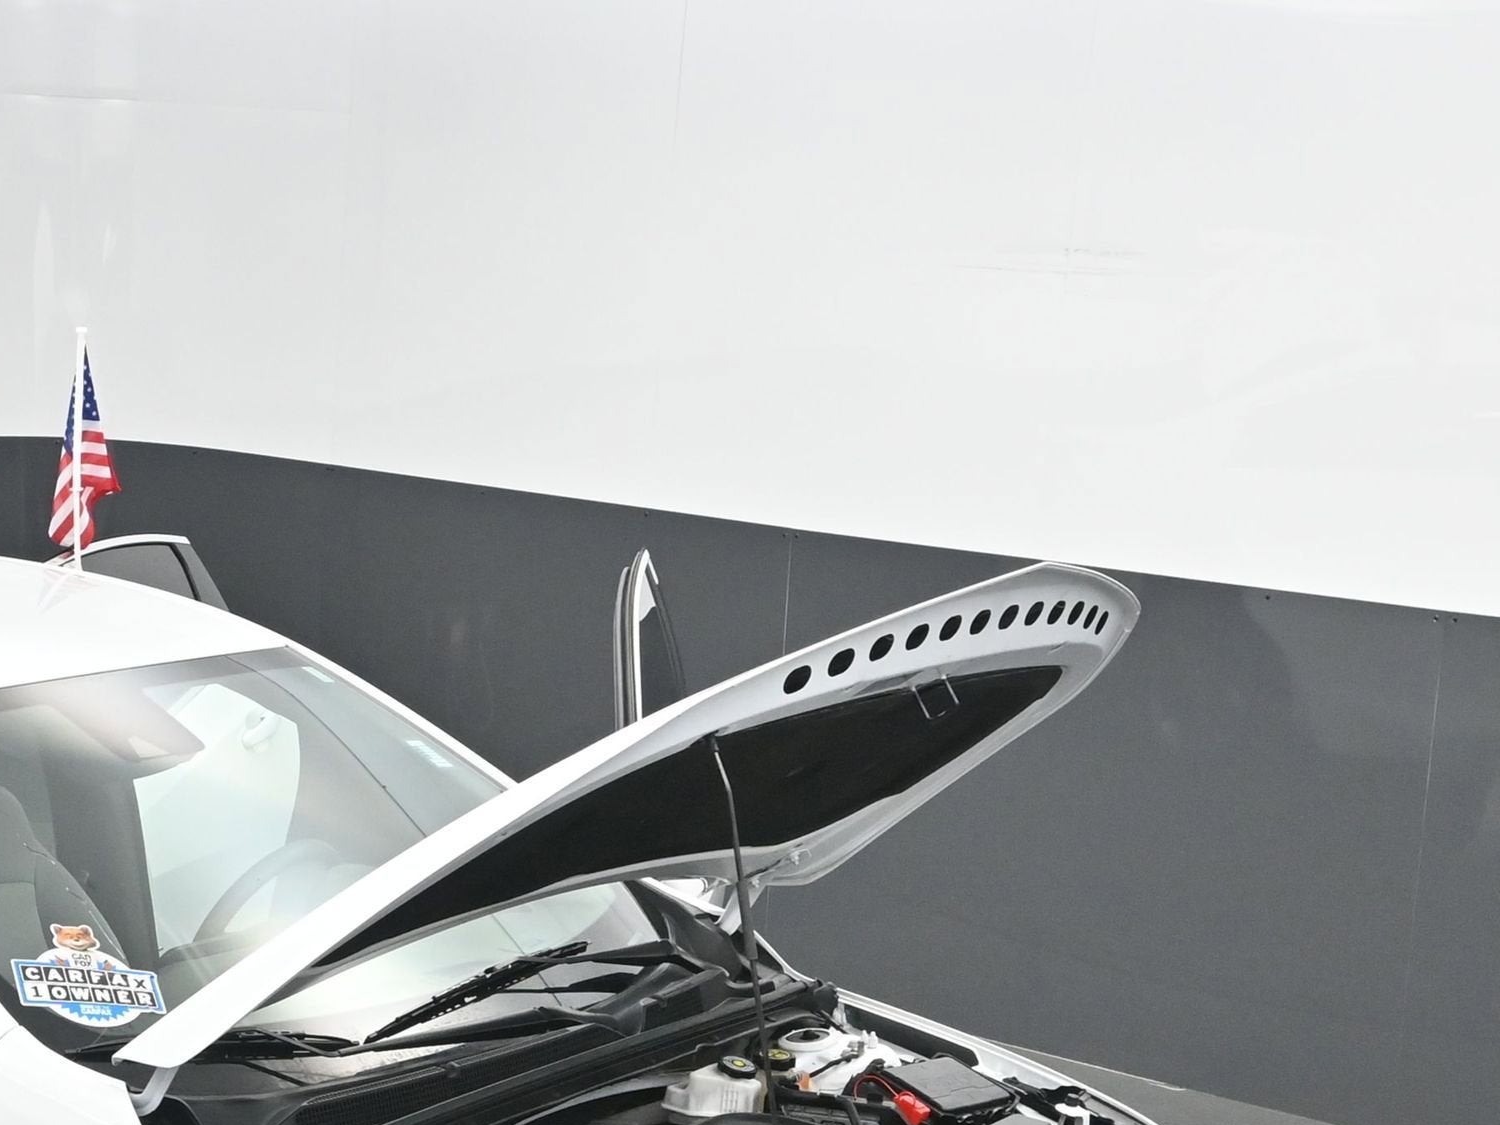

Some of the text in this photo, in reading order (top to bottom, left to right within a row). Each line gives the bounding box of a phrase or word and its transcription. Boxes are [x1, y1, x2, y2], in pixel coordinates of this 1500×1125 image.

[23, 966, 147, 990] CARFAX
[32, 985, 156, 1007] 1 OWNER
